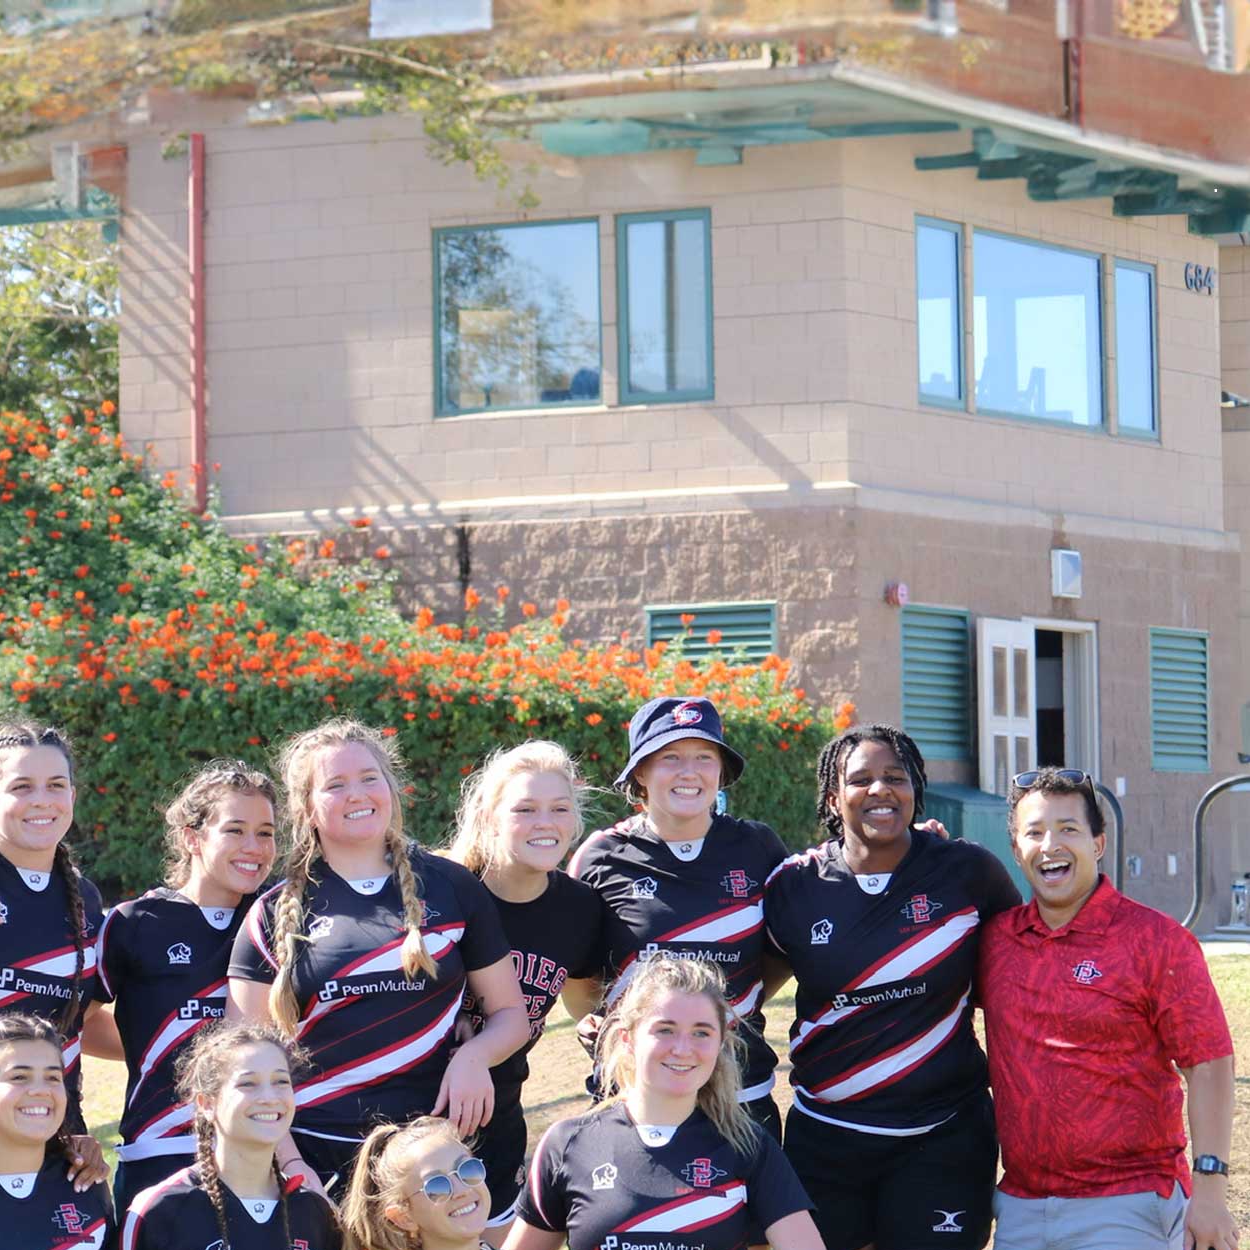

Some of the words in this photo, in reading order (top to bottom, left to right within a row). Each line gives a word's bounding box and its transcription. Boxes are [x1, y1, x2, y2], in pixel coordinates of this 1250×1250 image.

[1184, 262, 1214, 296] 684
[662, 949, 741, 963] PennMutual
[342, 978, 426, 997] PennMutual
[852, 982, 927, 1006] PennMutual
